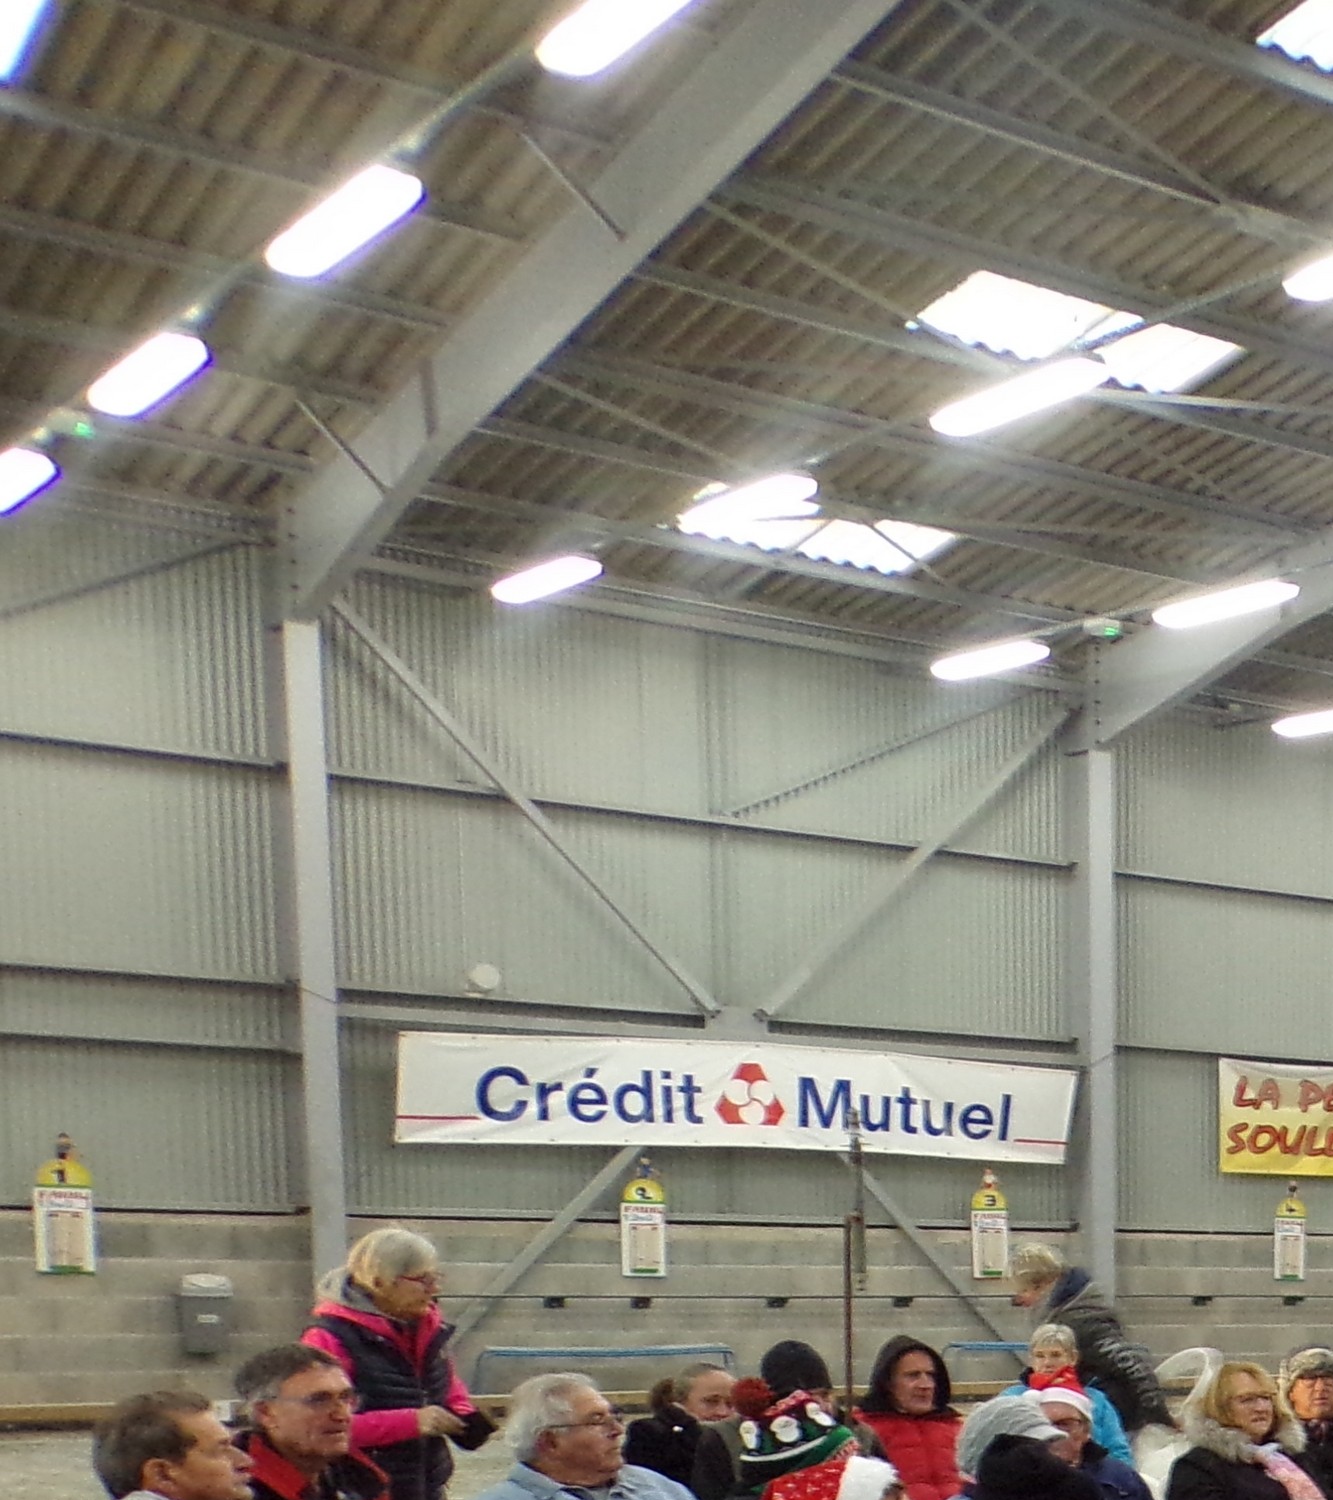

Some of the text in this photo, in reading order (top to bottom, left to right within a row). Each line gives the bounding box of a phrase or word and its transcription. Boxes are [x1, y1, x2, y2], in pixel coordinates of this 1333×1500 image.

[476, 1066, 1013, 1141] Crédit Mutuel
[1232, 1075, 1281, 1110] LA
[983, 1194, 997, 1207] 3
